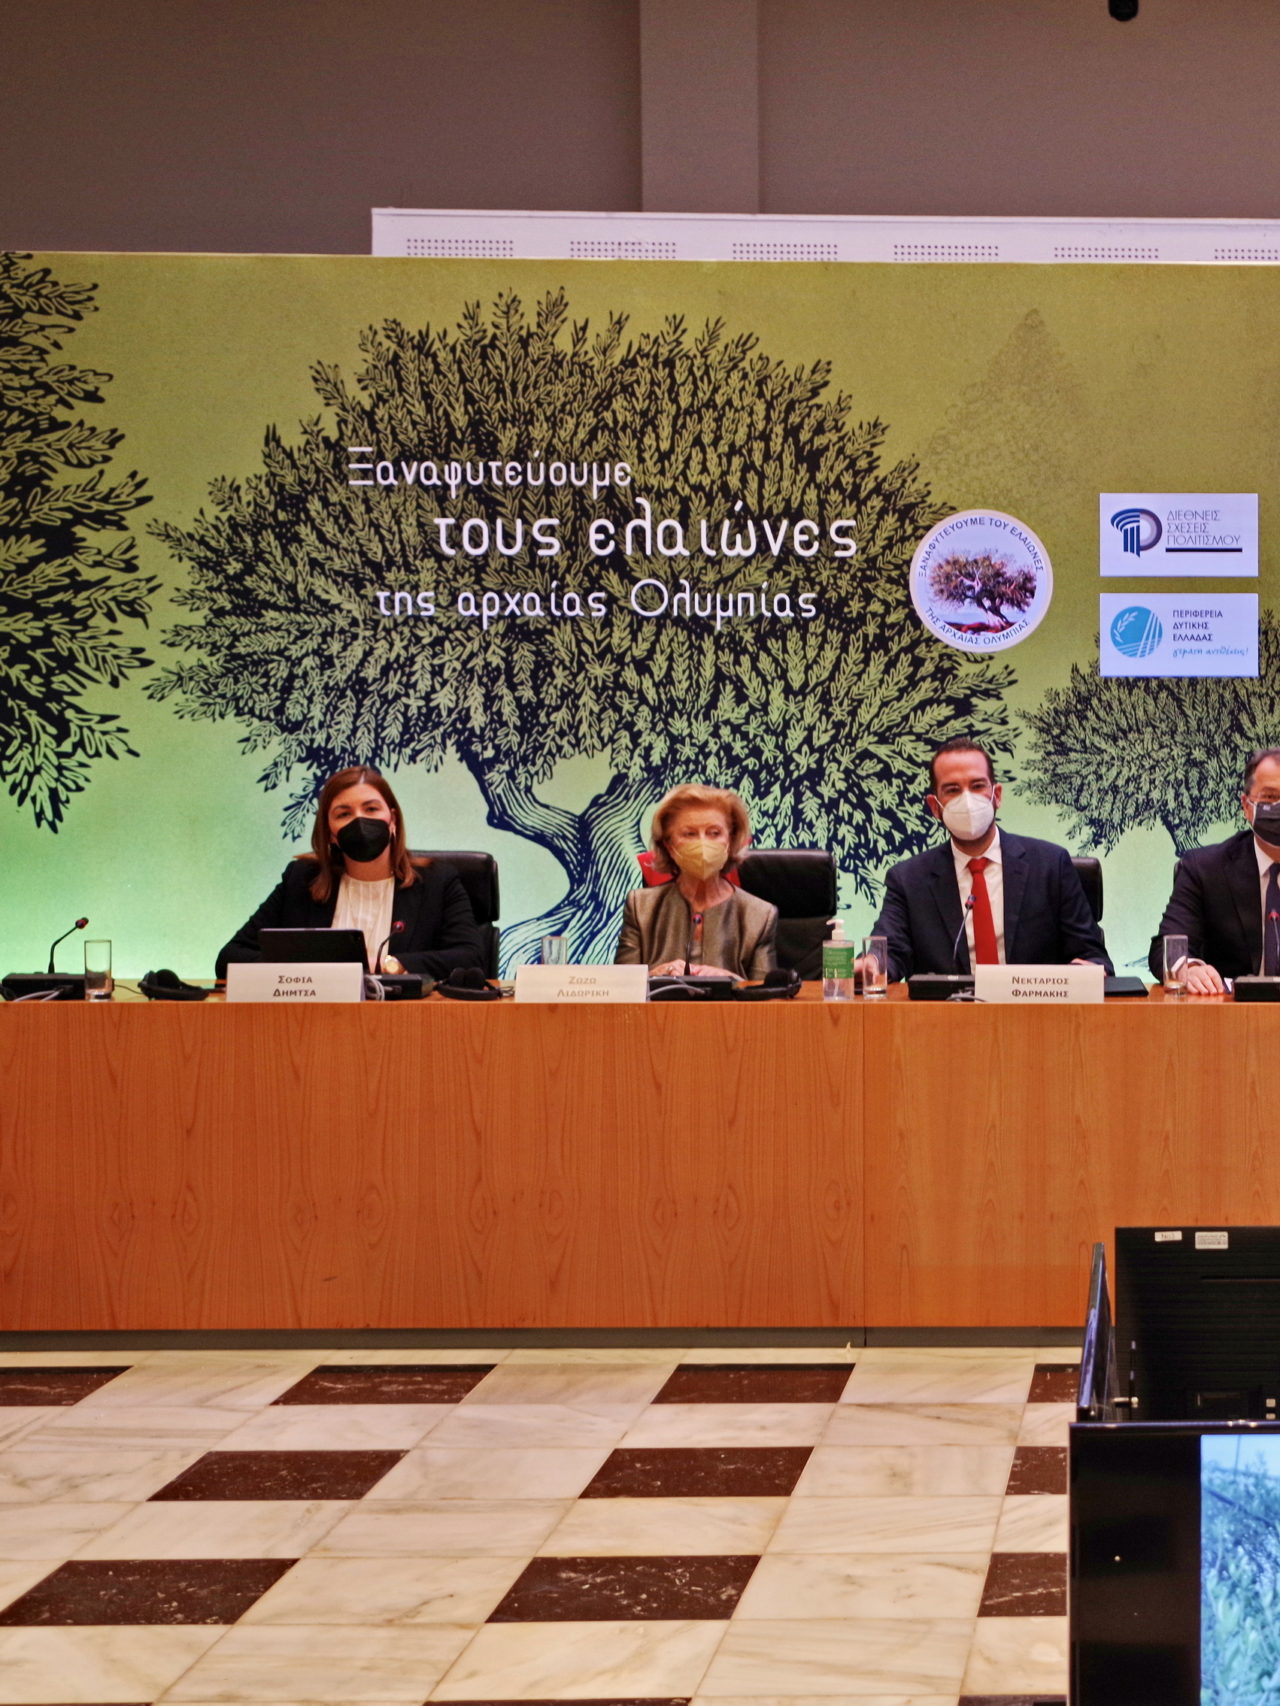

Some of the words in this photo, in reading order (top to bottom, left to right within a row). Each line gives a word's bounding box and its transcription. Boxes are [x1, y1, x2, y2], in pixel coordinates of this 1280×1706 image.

[347, 446, 632, 499] Ξαναφυτεύουμε
[1166, 510, 1221, 521] ΔΙΕΘΝΕΙΣ
[433, 517, 561, 557] τους
[588, 497, 858, 558] ελαιώνες
[1167, 522, 1210, 533] ΣΧΕΣΕΙΣ
[1167, 535, 1241, 546] ΠΟΛΙΤΙΣΜΟΥ
[376, 589, 436, 617] της
[456, 581, 607, 629] αρχαίας
[630, 578, 817, 629] Ολυμπίας
[1172, 610, 1223, 618] ΠΕΡΙΦΕΡΕΙΑ
[1172, 622, 1210, 630] ΔΥΤΙΚΗΣ
[1172, 633, 1212, 641] ΕΛΛΑΔΑΣ
[278, 975, 313, 984] ΣΟΦΙΑ
[1012, 976, 1069, 985] ΝΕΚΤΑΡΙΟΣ
[1012, 989, 1069, 998] ΦΑΡΜΑΚΗΣ
